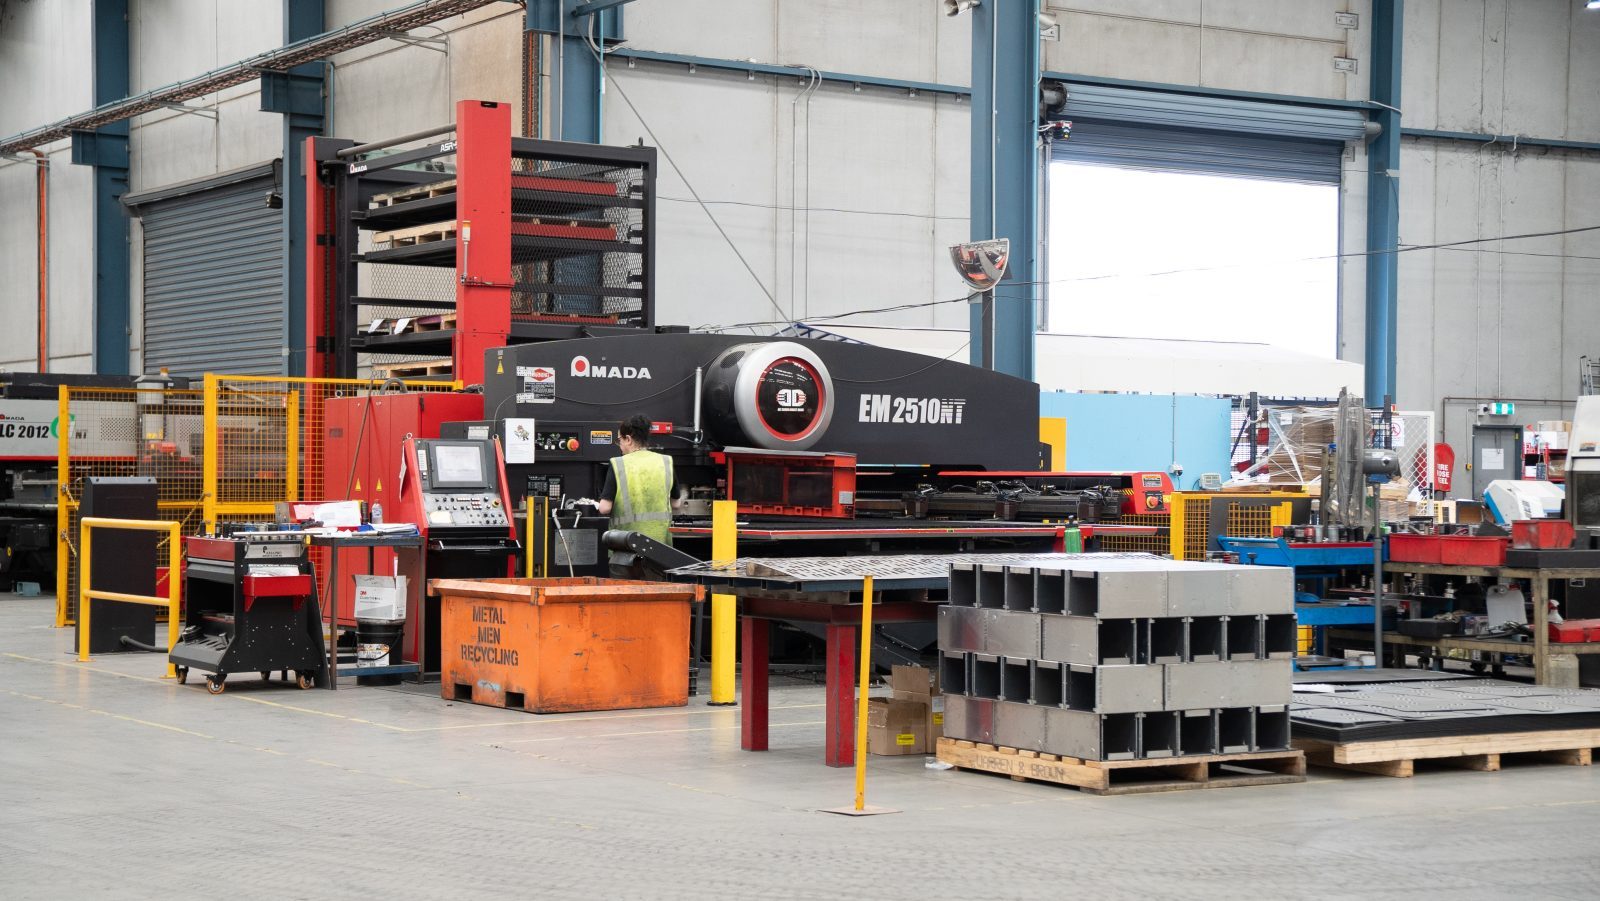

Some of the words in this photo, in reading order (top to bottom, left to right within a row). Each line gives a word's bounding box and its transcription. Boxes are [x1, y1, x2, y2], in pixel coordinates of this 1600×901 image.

[440, 141, 457, 153] ASR-
[570, 355, 652, 380] AMADA
[858, 394, 891, 423] EM
[18, 425, 49, 439] 2012
[472, 605, 506, 625] METAL
[477, 626, 501, 645] MEN
[461, 644, 519, 666] RECYCLING
